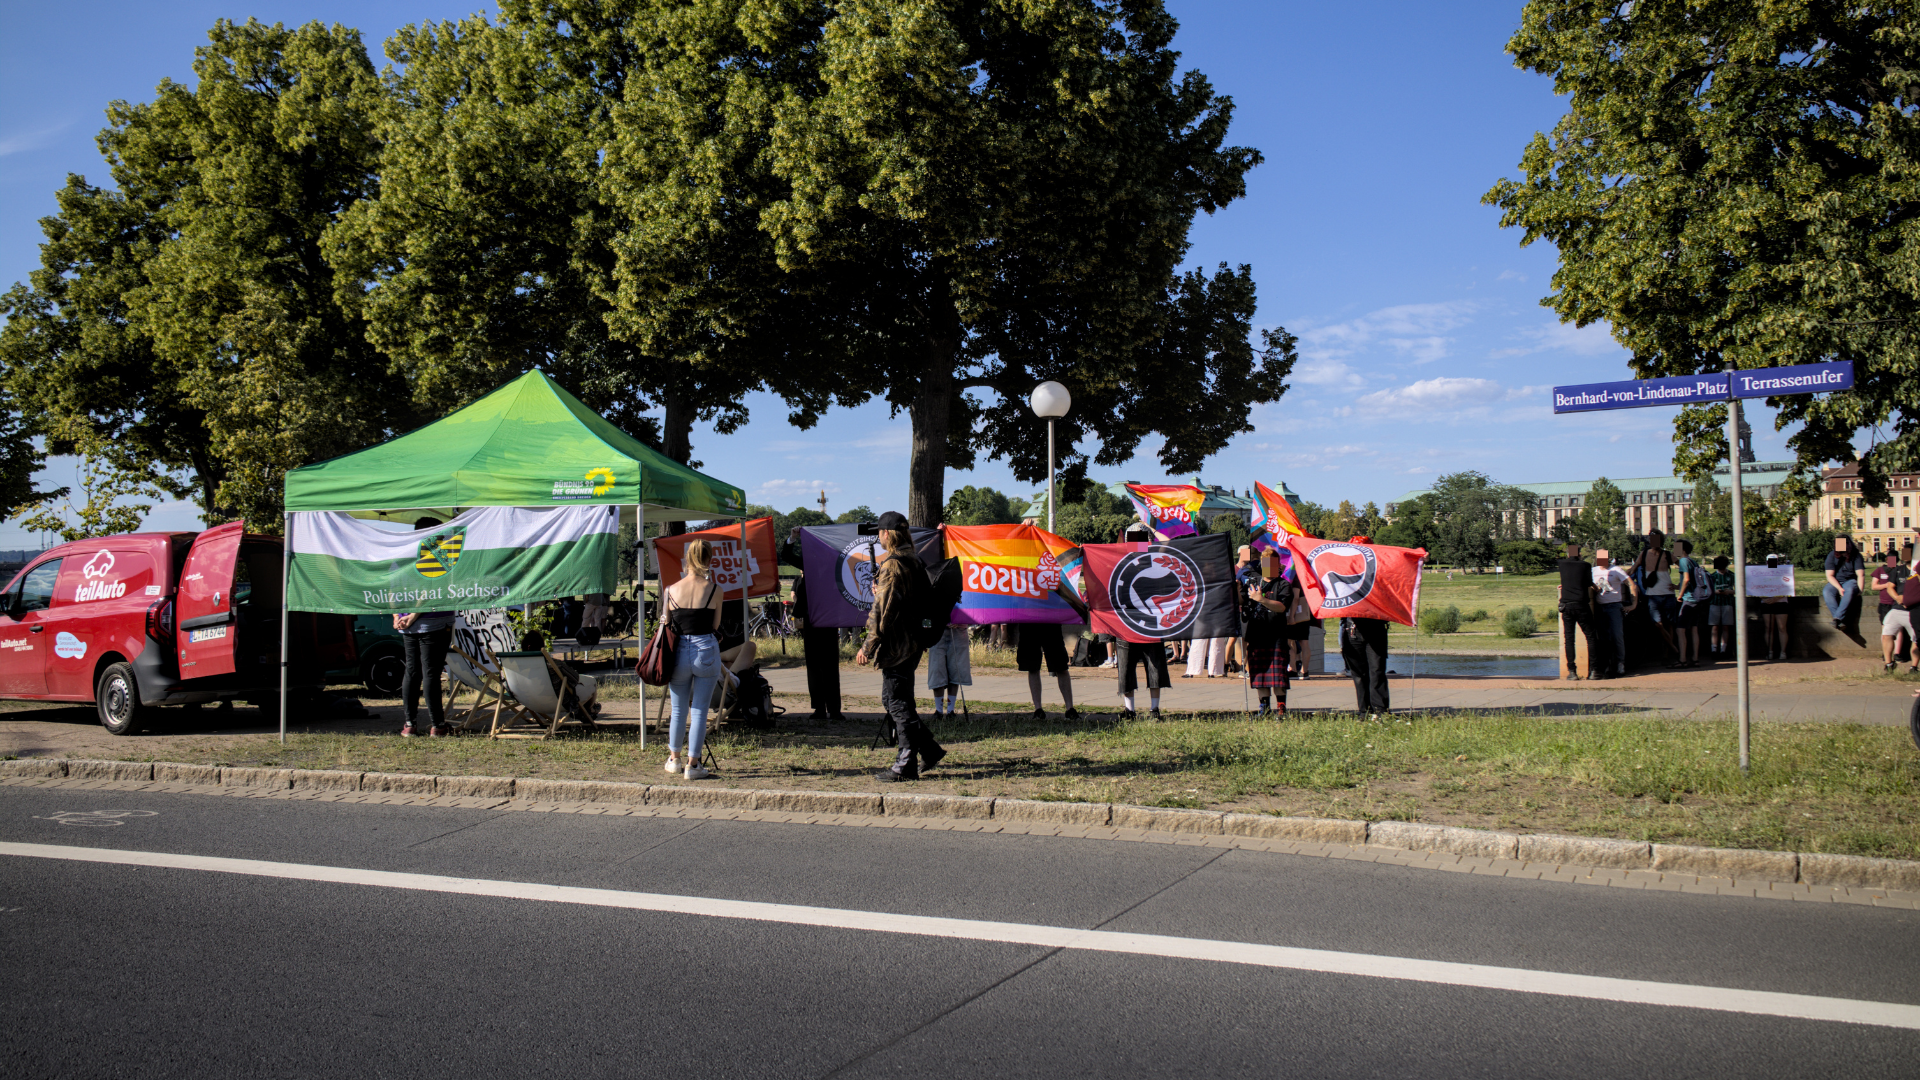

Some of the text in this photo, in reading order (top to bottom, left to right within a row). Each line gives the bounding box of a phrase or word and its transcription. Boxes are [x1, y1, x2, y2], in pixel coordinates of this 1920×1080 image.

[1741, 370, 1843, 390] Terrassenufer
[1556, 381, 1727, 406] Bernhard-von-Lindenau-Platz
[554, 480, 583, 488] BÜNDNIS
[75, 581, 126, 603] teilAuto
[363, 582, 511, 605] Polizeistaat Sachsen
